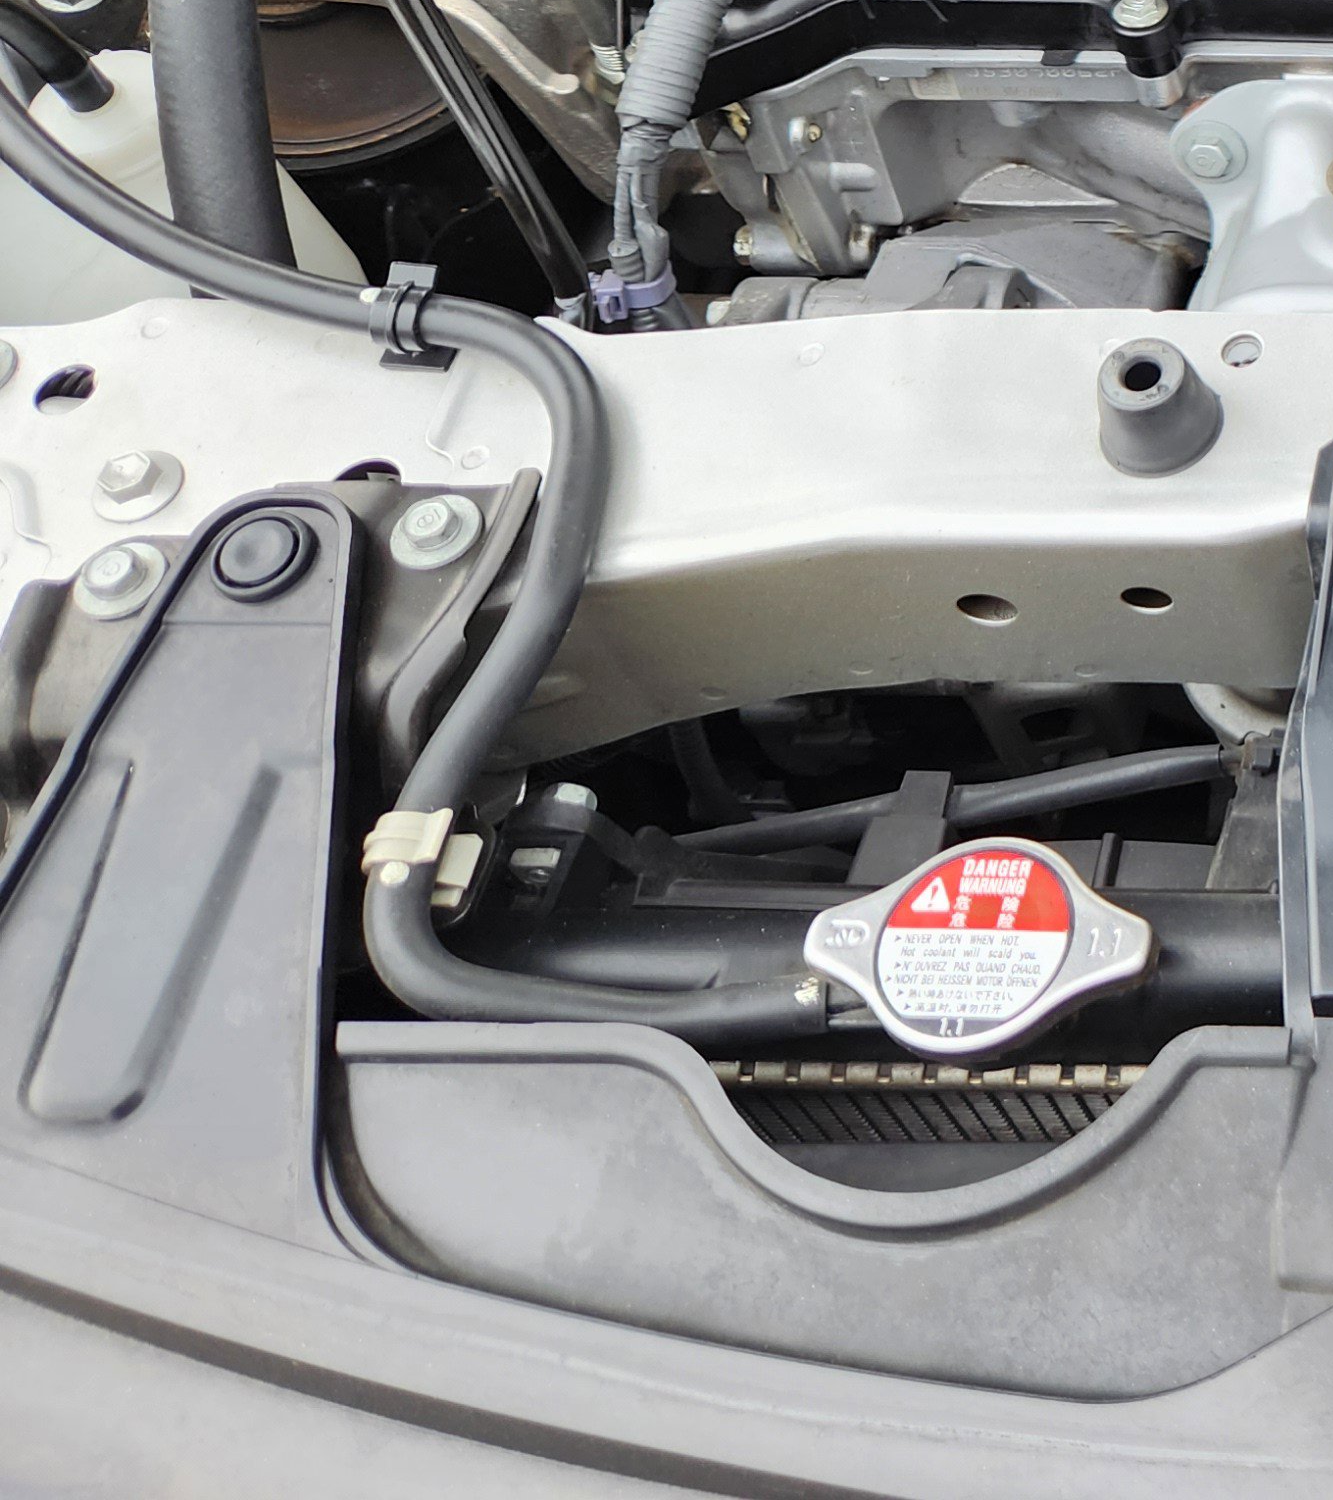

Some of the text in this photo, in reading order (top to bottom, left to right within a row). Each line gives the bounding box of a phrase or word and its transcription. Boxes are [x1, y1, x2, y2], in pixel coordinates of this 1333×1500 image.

[963, 859, 1032, 877] DANGER
[959, 877, 1027, 895] WARNUNG
[905, 933, 932, 945] NEVER
[939, 934, 962, 945] OPEN
[969, 935, 995, 946] WHEN
[1088, 927, 1122, 958] 1.1
[900, 947, 915, 958] Hot
[923, 947, 956, 958] coolant
[963, 948, 981, 958] will
[988, 948, 1012, 960] scald
[953, 961, 970, 972] PAS
[975, 962, 1006, 973] QUAND
[894, 974, 919, 985] NICHT
[920, 975, 935, 985] BEI
[937, 975, 973, 986] HEISSEN
[976, 976, 1003, 987] MOTOR
[939, 1016, 965, 1038] 1.1
